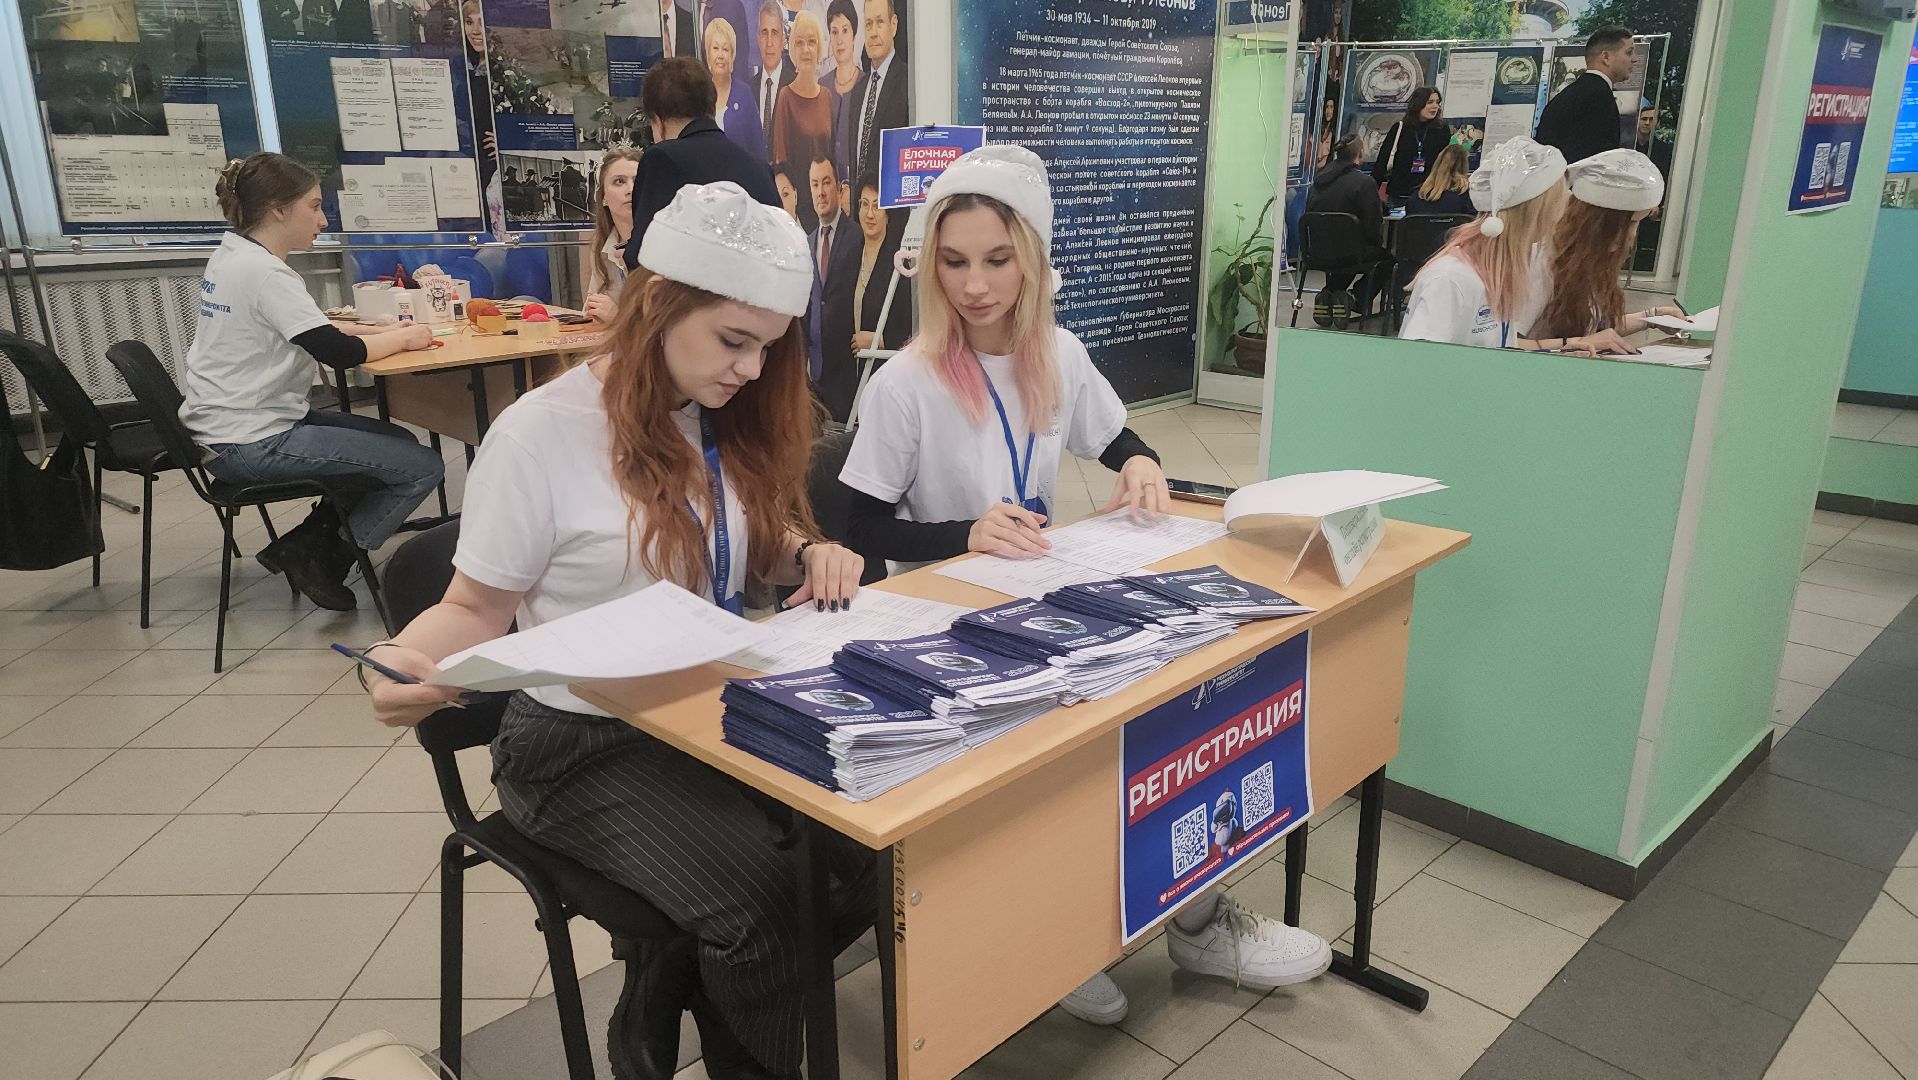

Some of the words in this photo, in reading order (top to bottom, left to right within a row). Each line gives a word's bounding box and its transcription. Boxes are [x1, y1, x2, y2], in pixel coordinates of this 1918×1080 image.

[1046, 9, 1056, 21] 30
[1058, 13, 1074, 23] мая
[1075, 12, 1091, 24] 1934
[1103, 14, 1108, 26] 11
[1110, 17, 1140, 31] октября
[1142, 18, 1157, 30] 2019
[1108, 38, 1126, 50] Герой
[1010, 47, 1061, 60] генерал-майор
[1000, 67, 1007, 76] 18
[1008, 70, 1028, 79] марта
[1029, 68, 1043, 78] 1965
[1044, 70, 1059, 80] года
[991, 83, 1020, 93] истории
[1024, 84, 1070, 94] человечества
[983, 97, 1032, 107] пространство
[1042, 96, 1062, 107] борта
[1066, 98, 1092, 108] корабля
[1808, 92, 1870, 122] РЕГИСТРАЦИЯ
[1035, 110, 1060, 119] Леонов
[1056, 124, 1062, 133] 12
[1064, 126, 1083, 135] минут
[904, 149, 956, 160] ЁЛОЧНАЯ
[1056, 185, 1063, 193] со
[1074, 213, 1093, 224] своей
[1099, 272, 1112, 283] 2015
[1129, 688, 1302, 817] РЕГИСТРАЦИЯ
